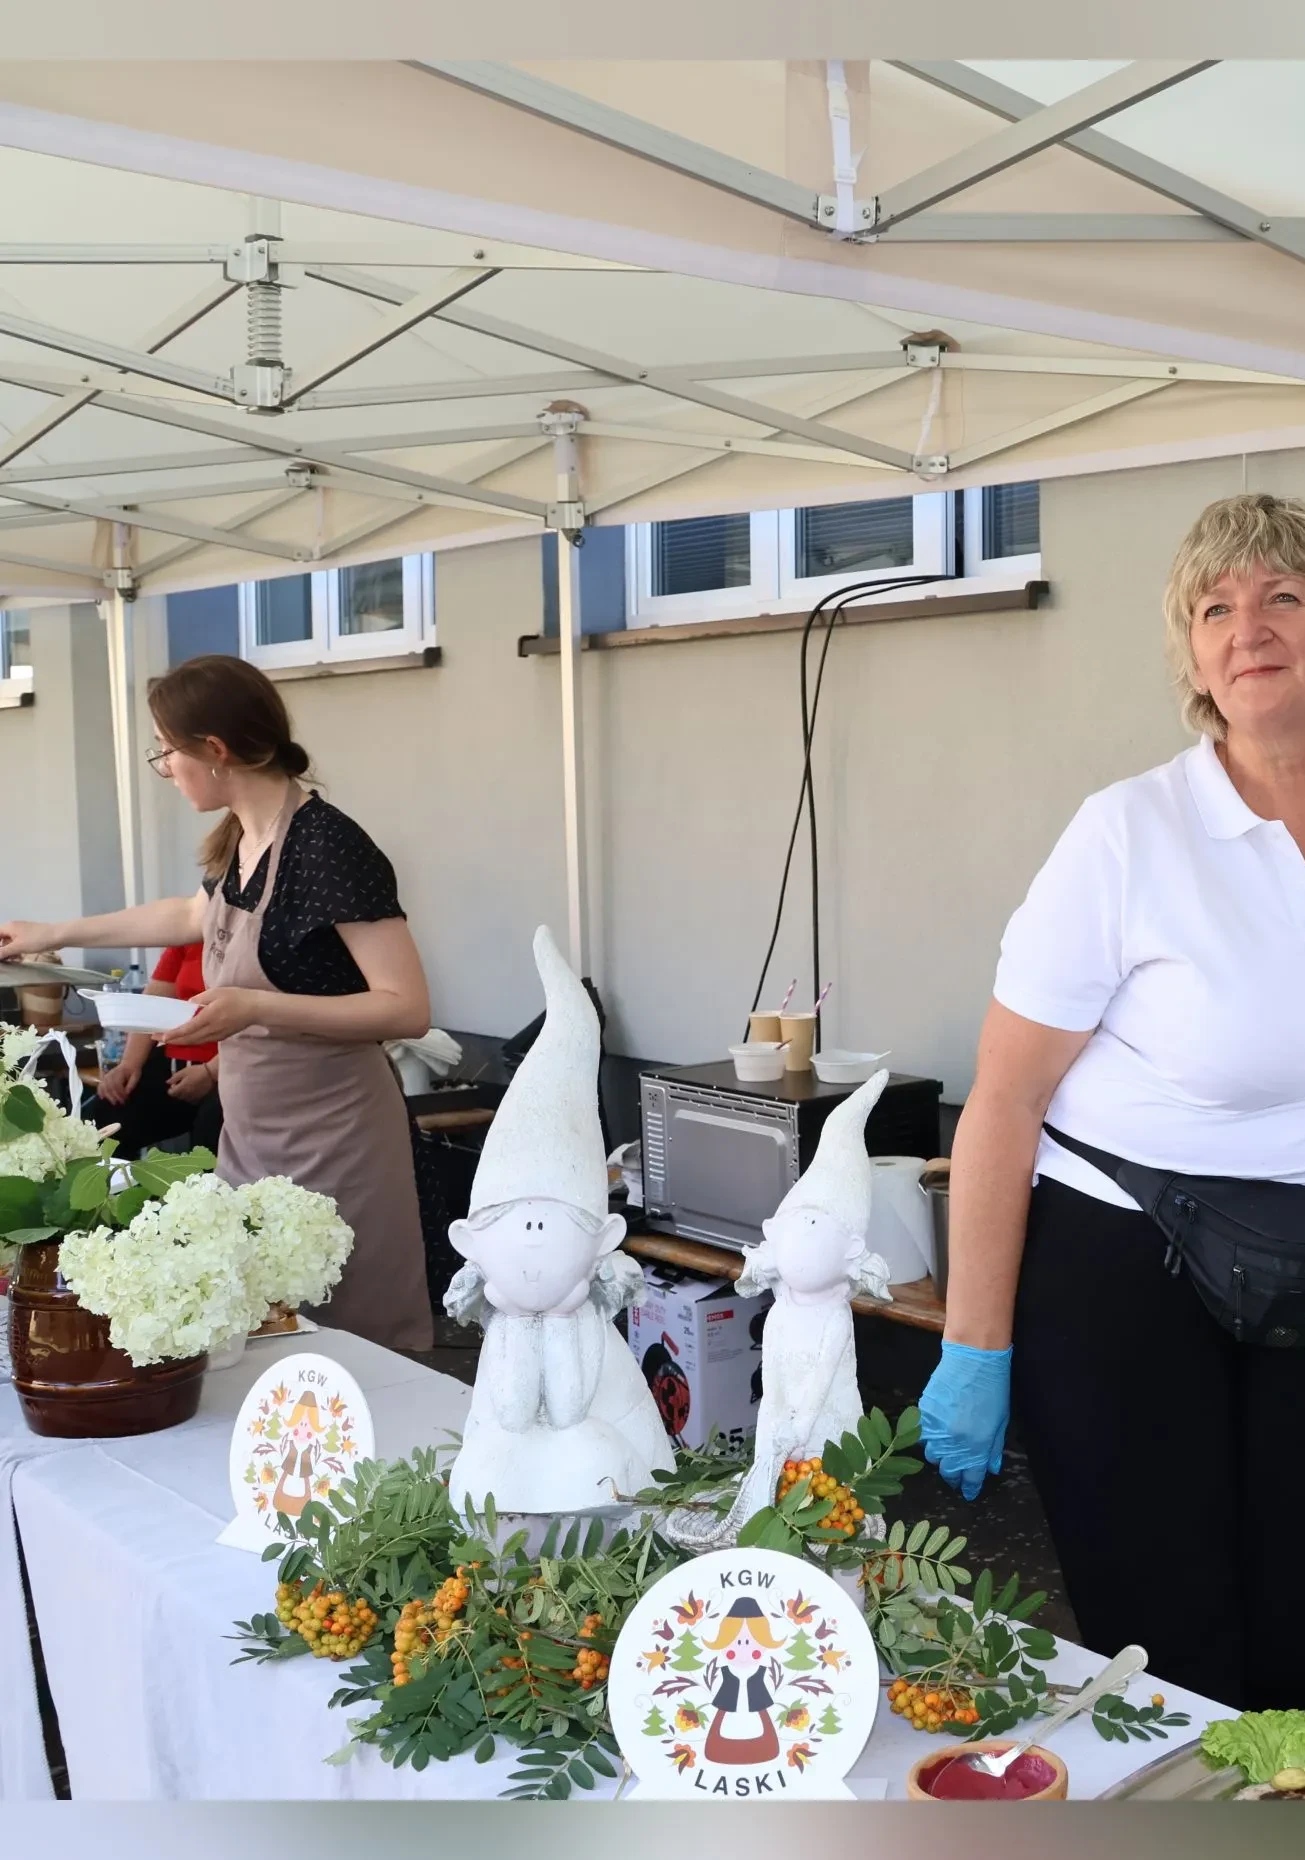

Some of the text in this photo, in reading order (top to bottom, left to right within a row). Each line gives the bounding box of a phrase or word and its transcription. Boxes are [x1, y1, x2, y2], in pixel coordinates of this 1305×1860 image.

[298, 1369, 328, 1387] KGW
[720, 1569, 776, 1589] KGW
[694, 1769, 787, 1797] LASKI
